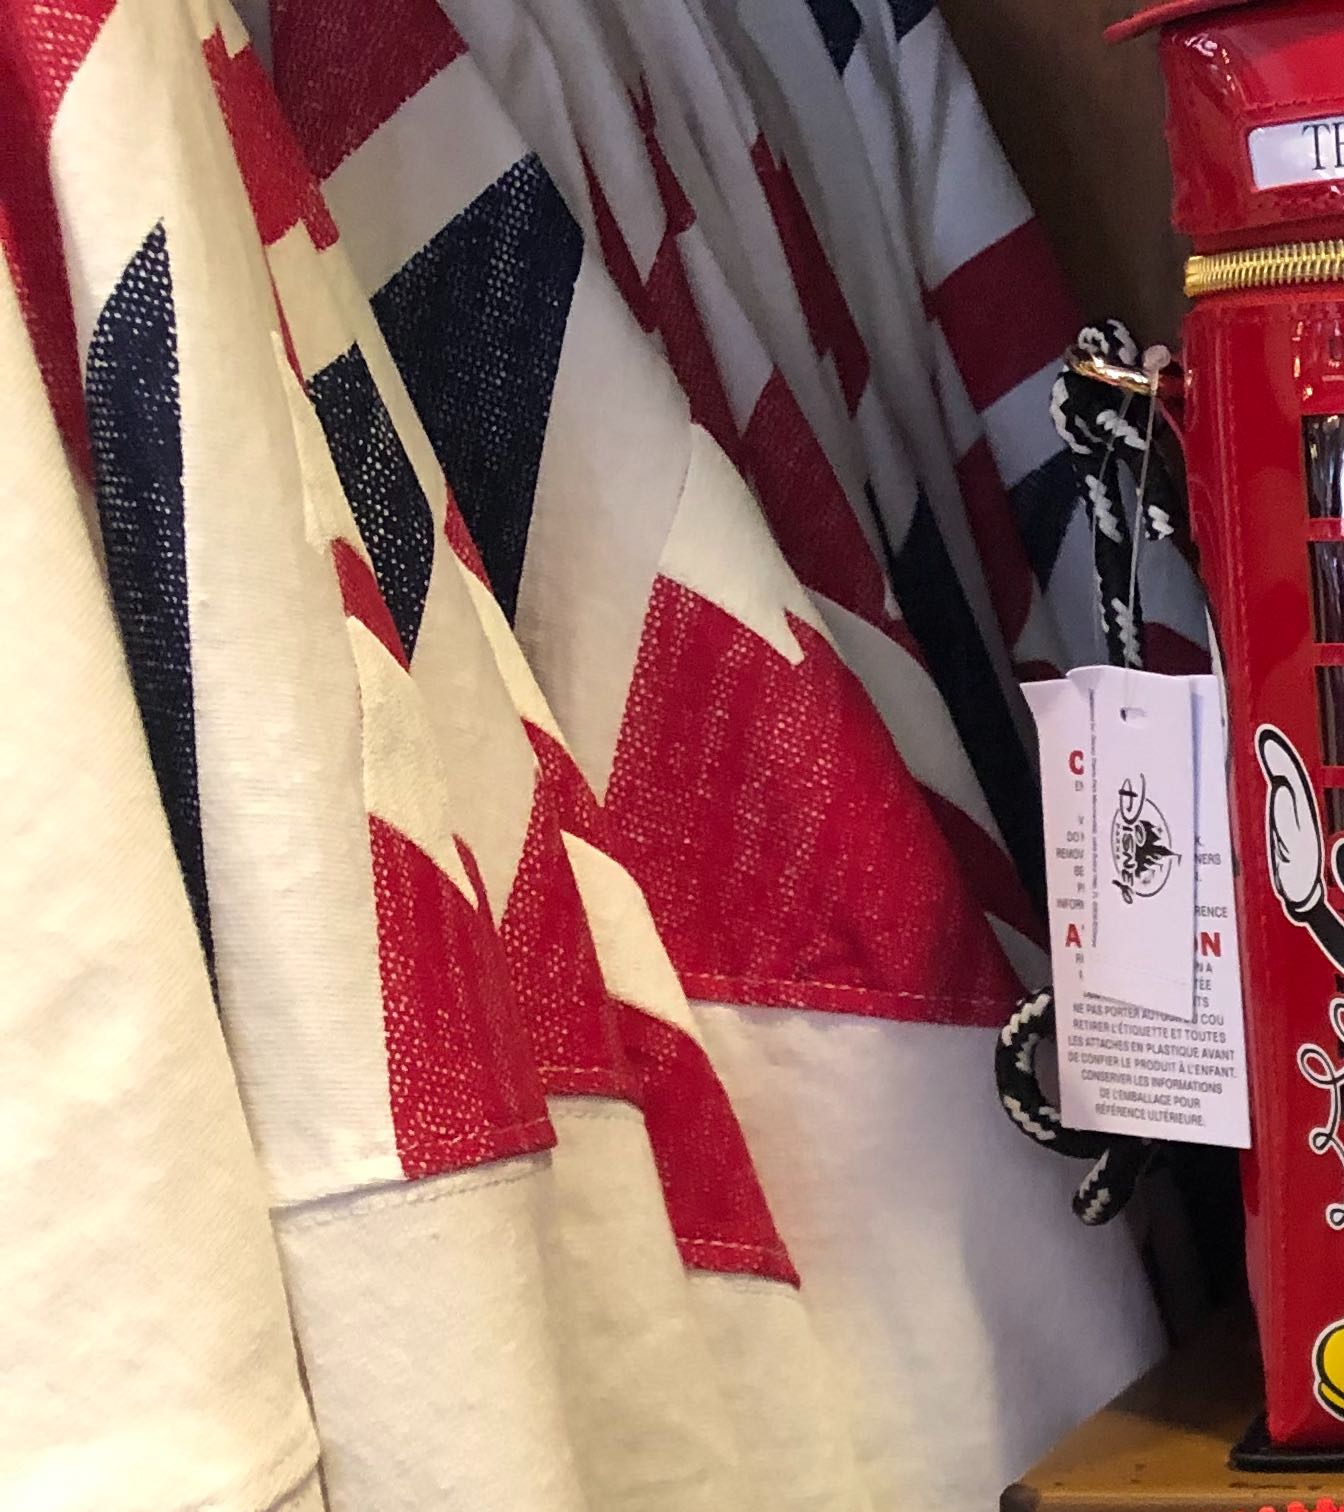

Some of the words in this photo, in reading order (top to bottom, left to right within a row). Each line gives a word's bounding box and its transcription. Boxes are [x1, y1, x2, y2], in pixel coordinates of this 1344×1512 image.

[1200, 1013, 1225, 1026] COU
[1170, 1027, 1182, 1040] ET
[1184, 1028, 1226, 1044] TOUTES
[1146, 1043, 1199, 1058] PLASTIQUE
[1201, 1048, 1235, 1061] AVANT
[1121, 1057, 1132, 1069] LE
[1134, 1058, 1176, 1073] PRODUIT
[1151, 1077, 1223, 1095] INFORMATIONS
[1173, 1096, 1200, 1109] POUR
